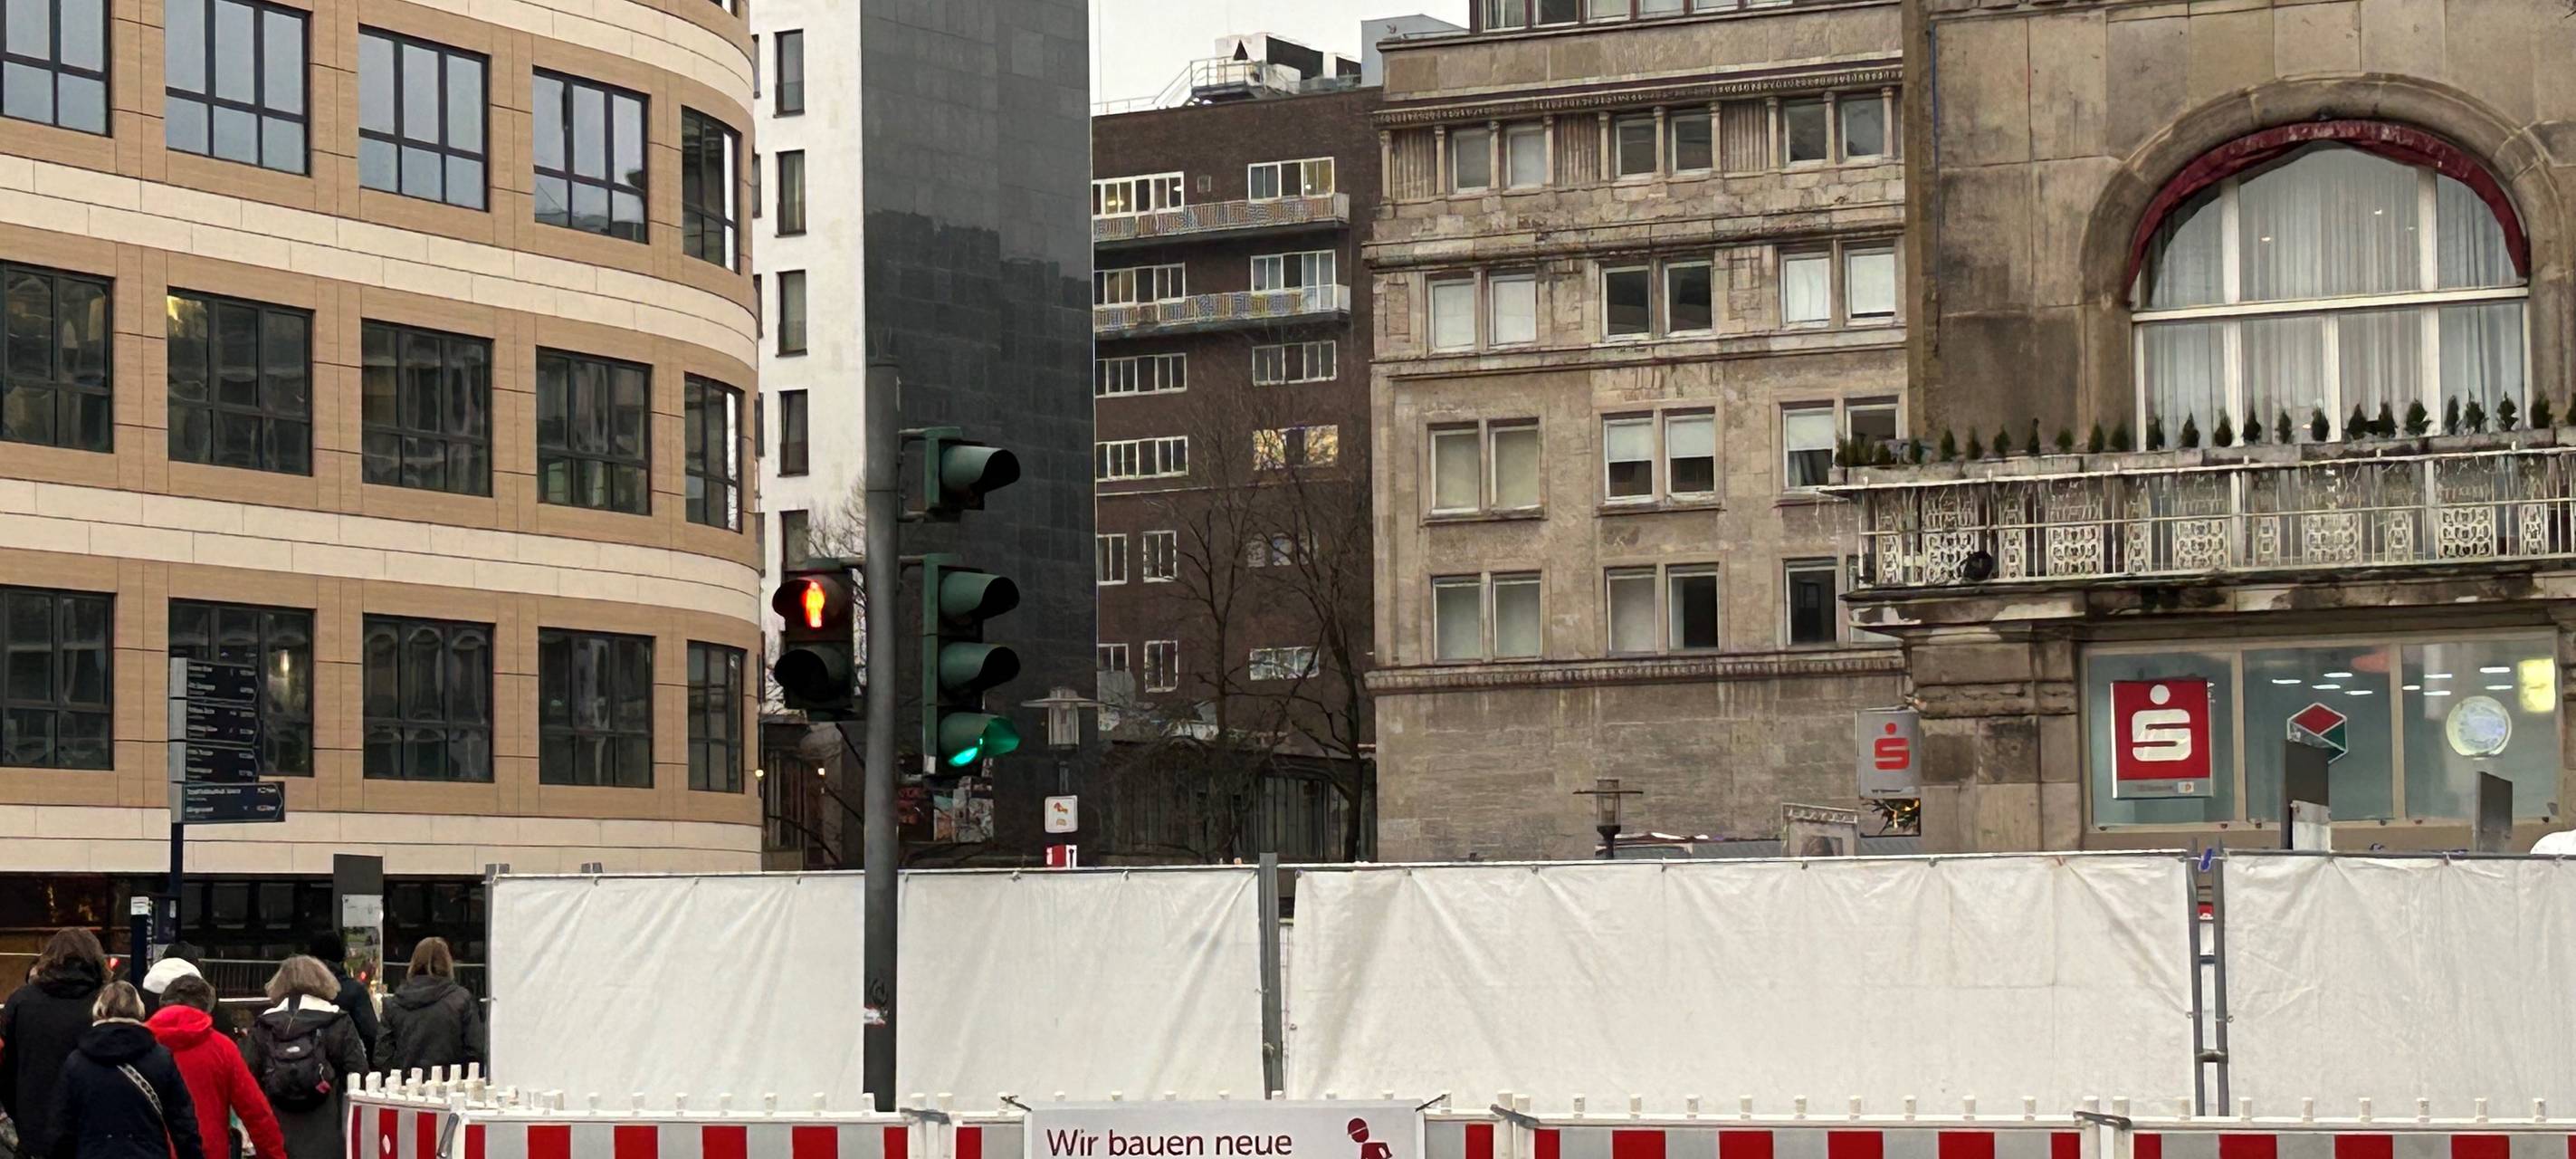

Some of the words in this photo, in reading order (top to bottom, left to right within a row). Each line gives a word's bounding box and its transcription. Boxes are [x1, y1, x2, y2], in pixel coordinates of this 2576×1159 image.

[1046, 1128, 1099, 1156] Wir
[1109, 1128, 1204, 1156] bauen
[1215, 1135, 1293, 1156] neue
